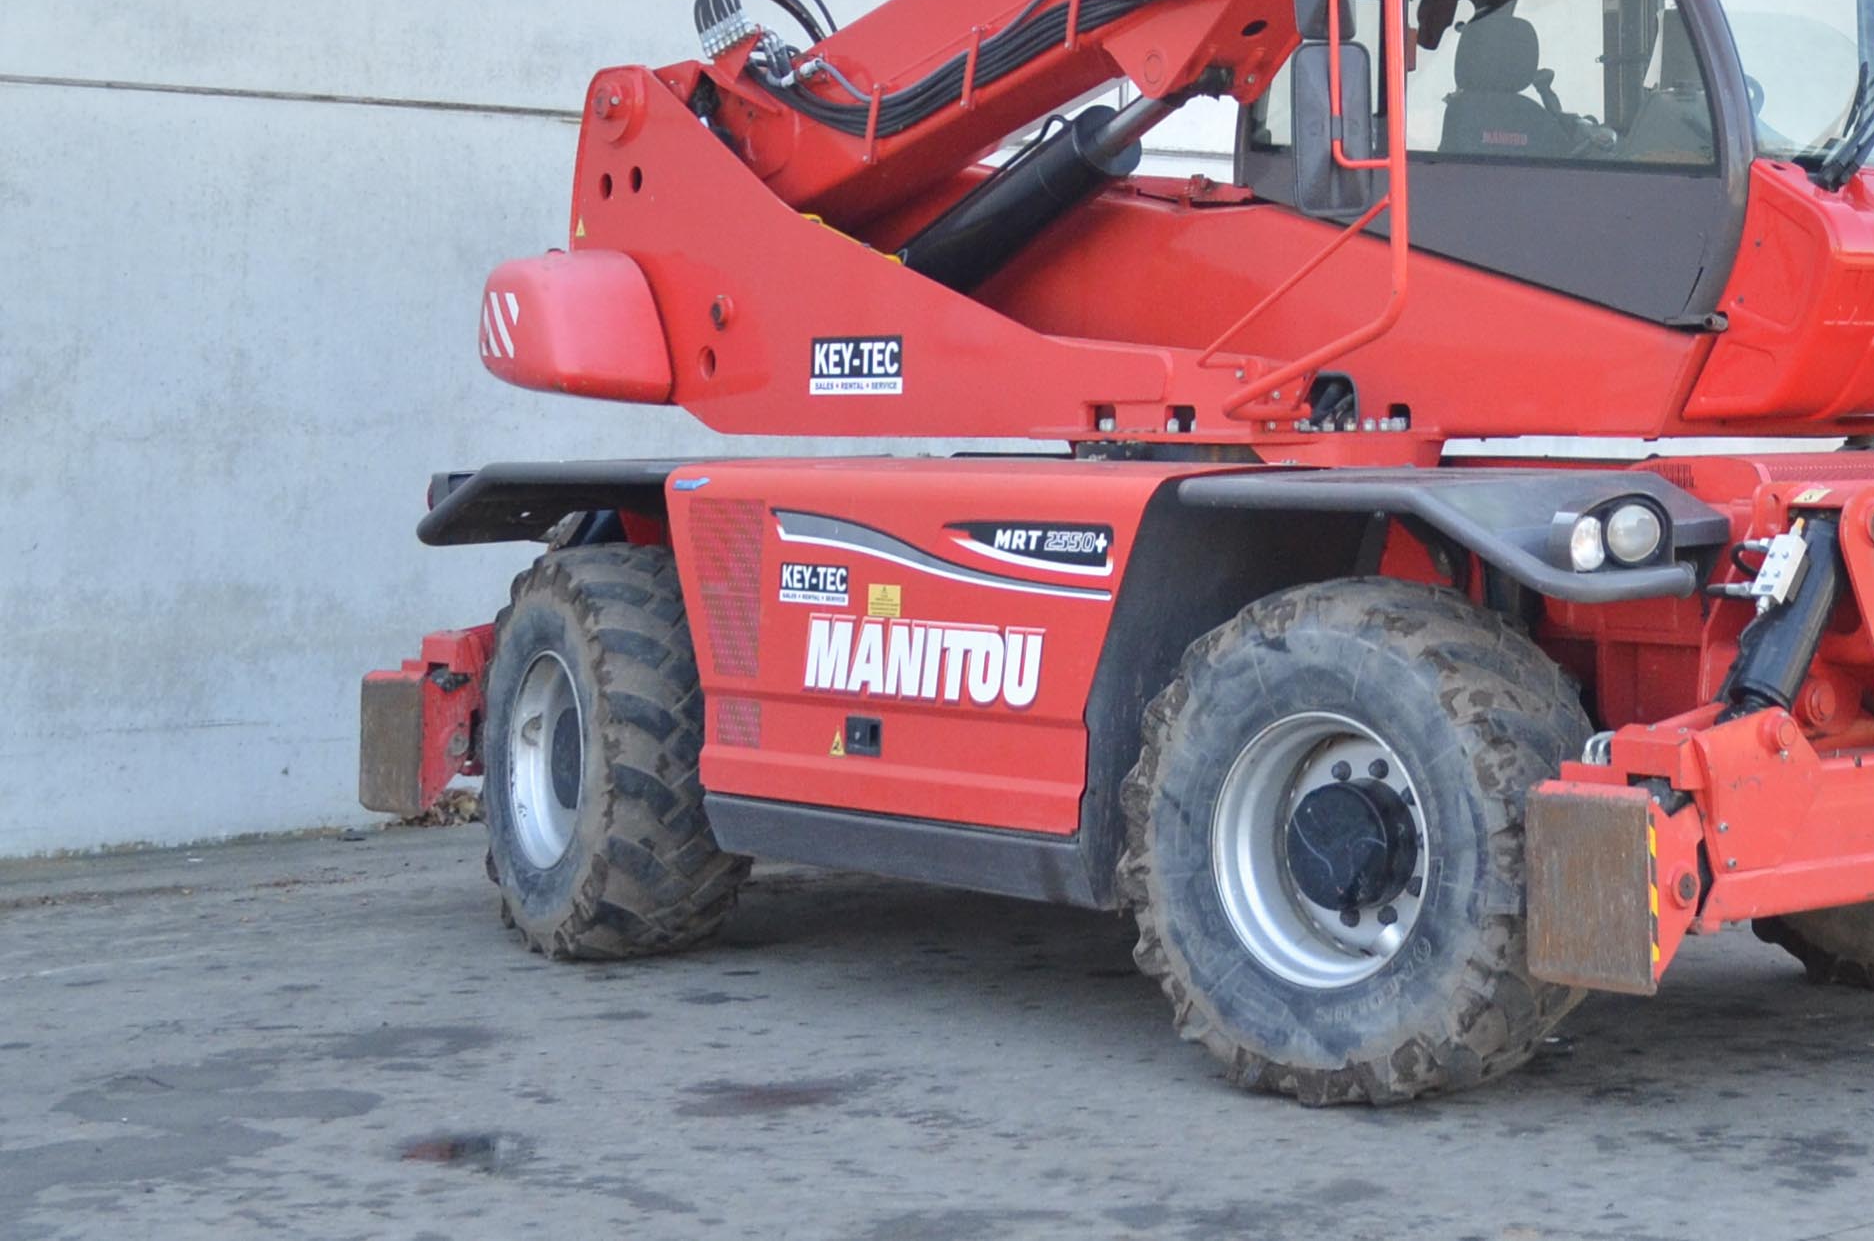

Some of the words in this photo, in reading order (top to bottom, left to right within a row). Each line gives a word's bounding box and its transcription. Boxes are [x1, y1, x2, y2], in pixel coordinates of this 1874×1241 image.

[814, 341, 899, 375] KEY-TEC
[815, 382, 834, 390] SALES
[841, 382, 864, 390] RENTAL
[871, 382, 897, 390] SERVICE
[994, 529, 1042, 550] MRT
[781, 564, 847, 591] KEY-TEC
[803, 613, 1046, 706] MANITOU
